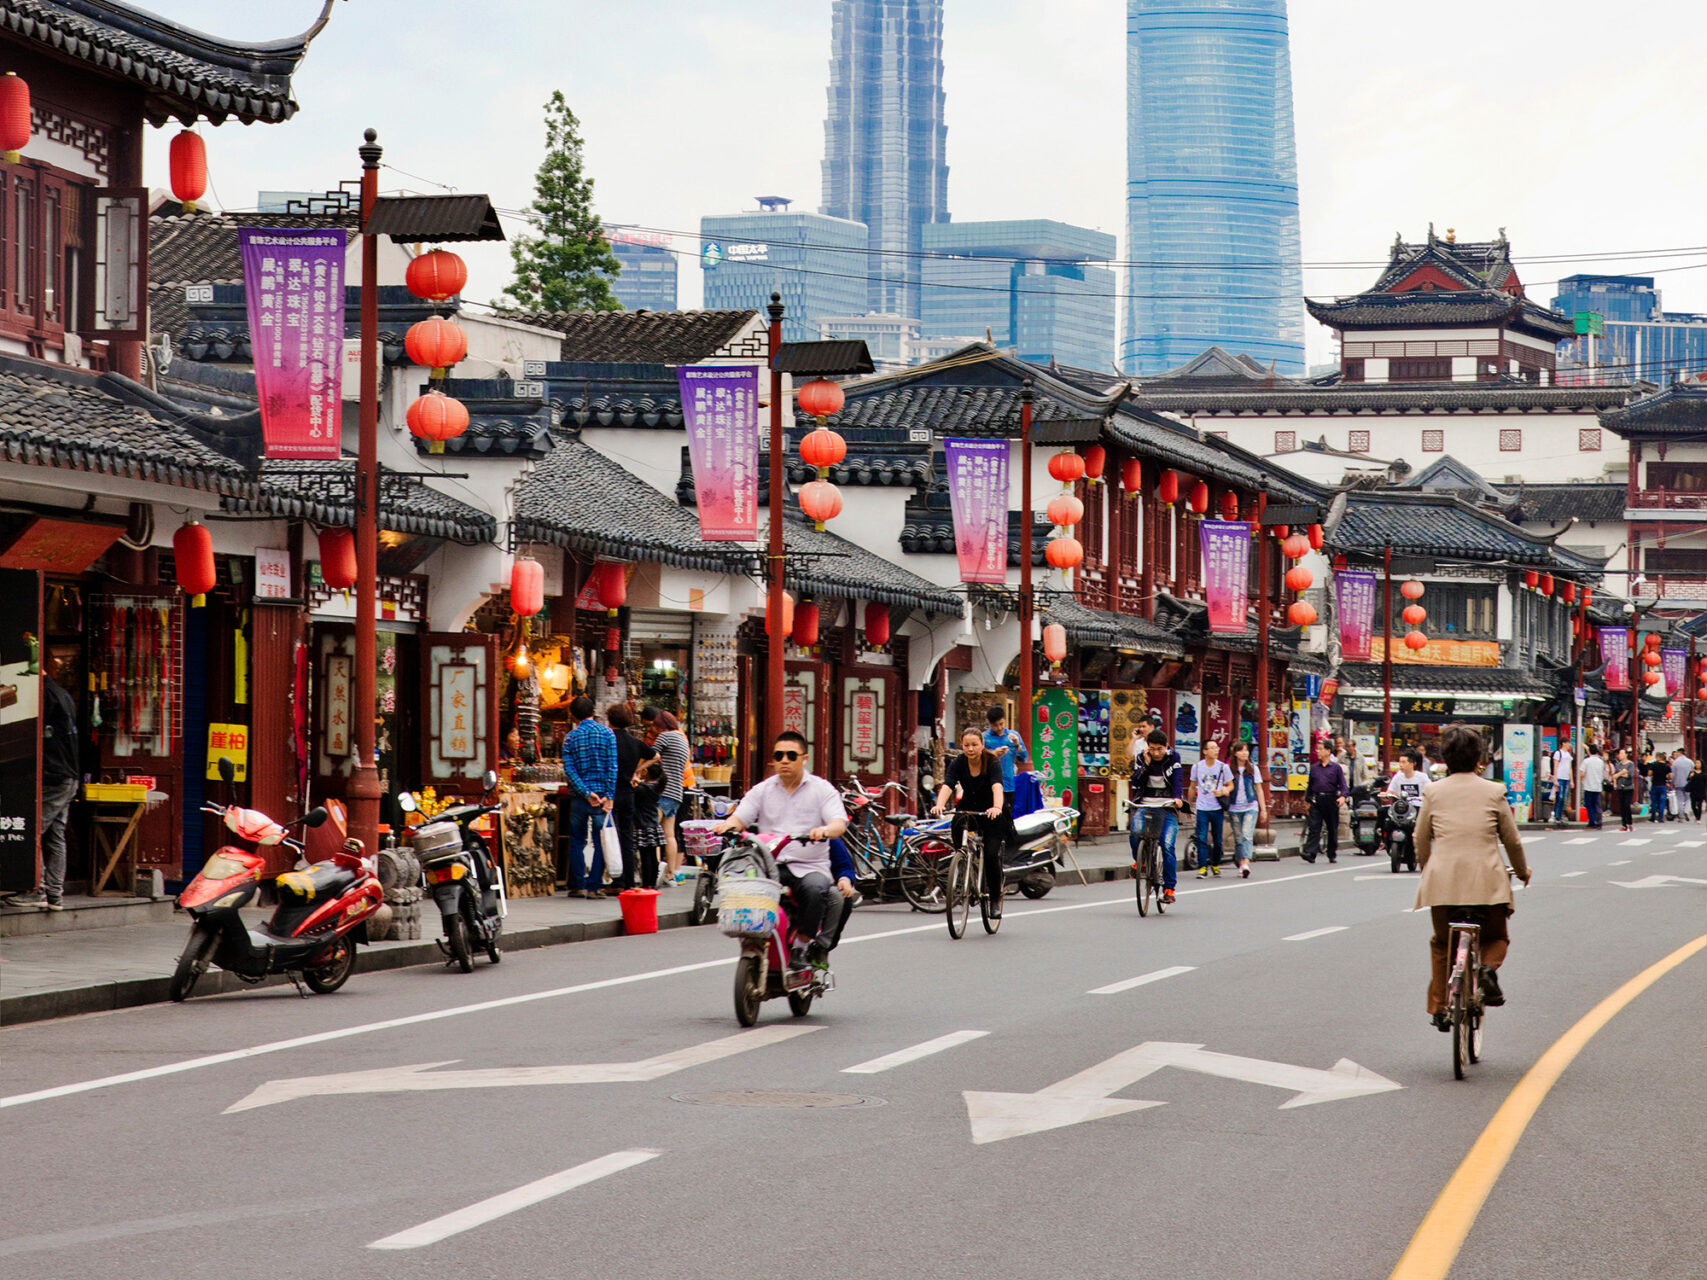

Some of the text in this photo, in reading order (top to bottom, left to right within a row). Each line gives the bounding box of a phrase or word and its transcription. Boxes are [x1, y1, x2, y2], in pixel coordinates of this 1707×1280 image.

[333, 661, 347, 750] 天然水晶
[450, 670, 467, 753] 厂家直销
[856, 695, 873, 755] 碧玺宝石
[210, 731, 245, 750] 崖柏
[1509, 760, 1527, 792] 老味道
